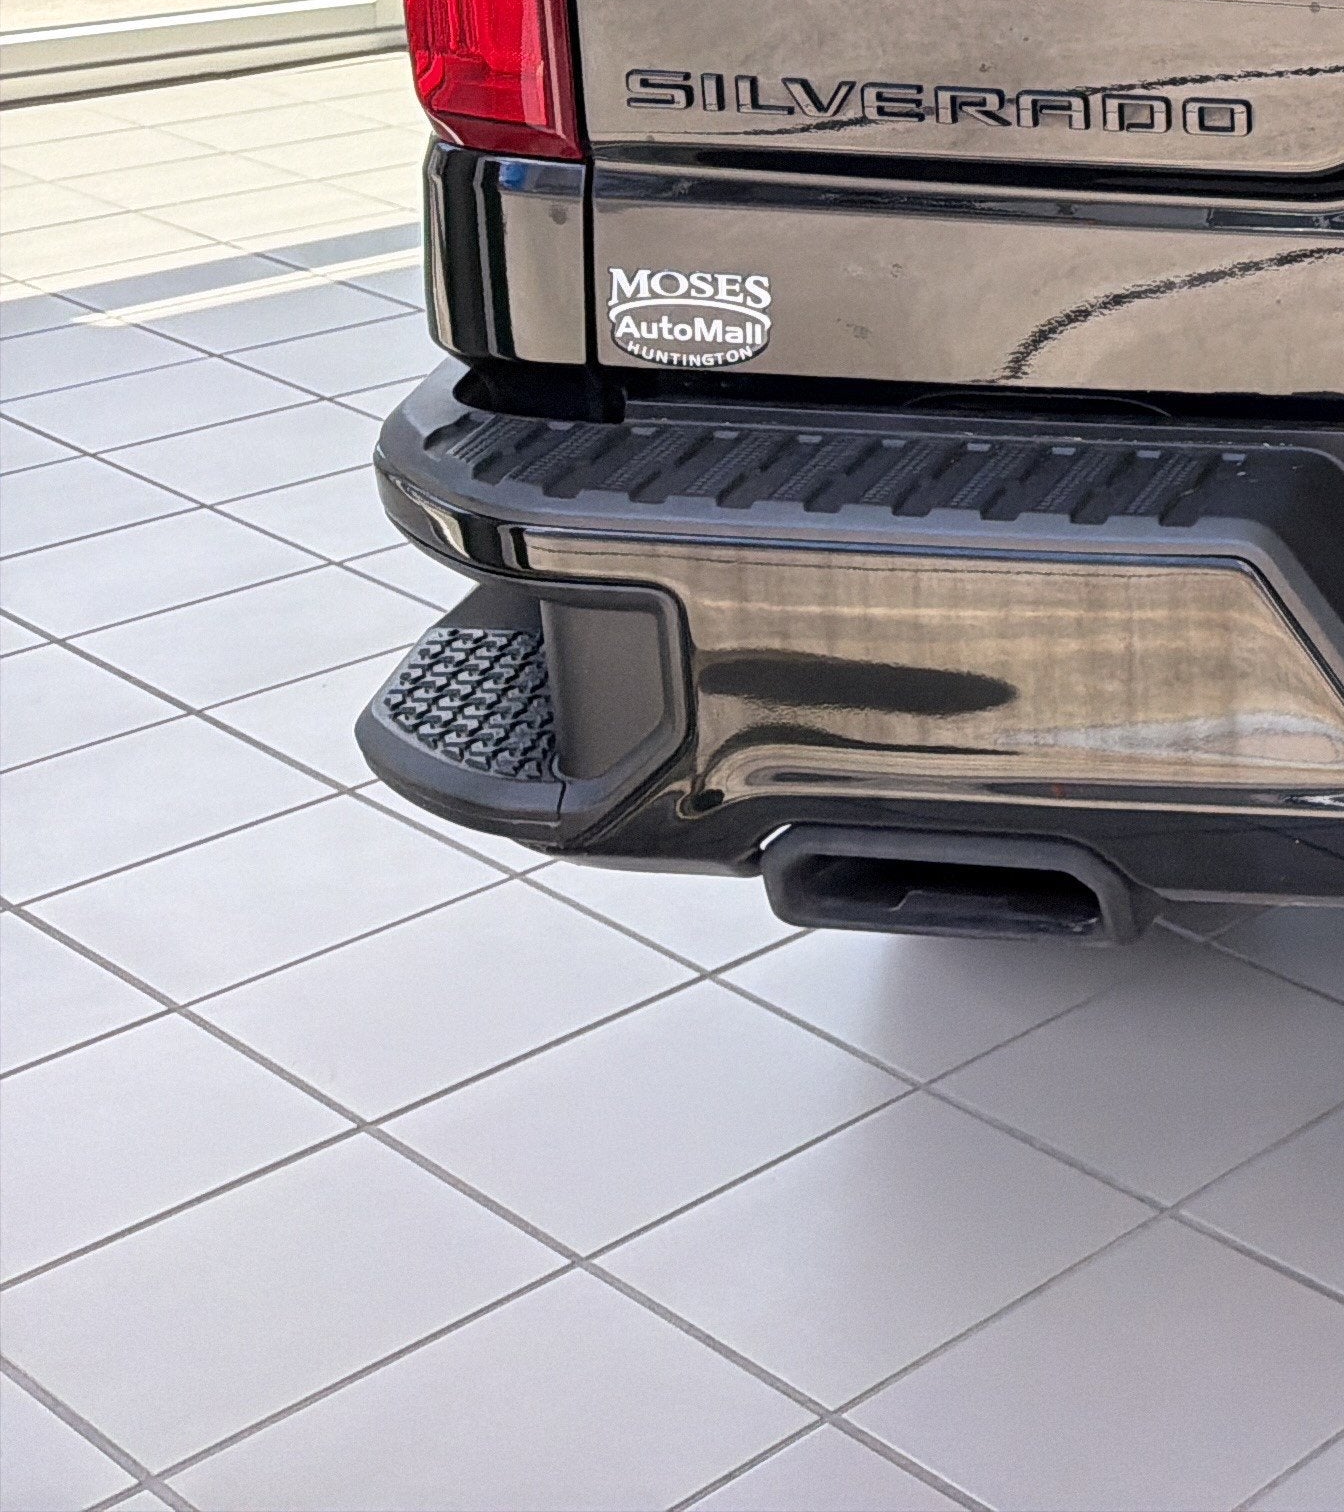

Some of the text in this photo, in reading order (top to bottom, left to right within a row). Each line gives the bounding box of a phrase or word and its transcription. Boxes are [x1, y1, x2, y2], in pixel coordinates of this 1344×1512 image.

[624, 68, 1253, 138] SILVERADO
[608, 268, 772, 308] MOSES
[615, 315, 762, 345] AutoMall
[626, 341, 753, 367] HUNTINGTON
